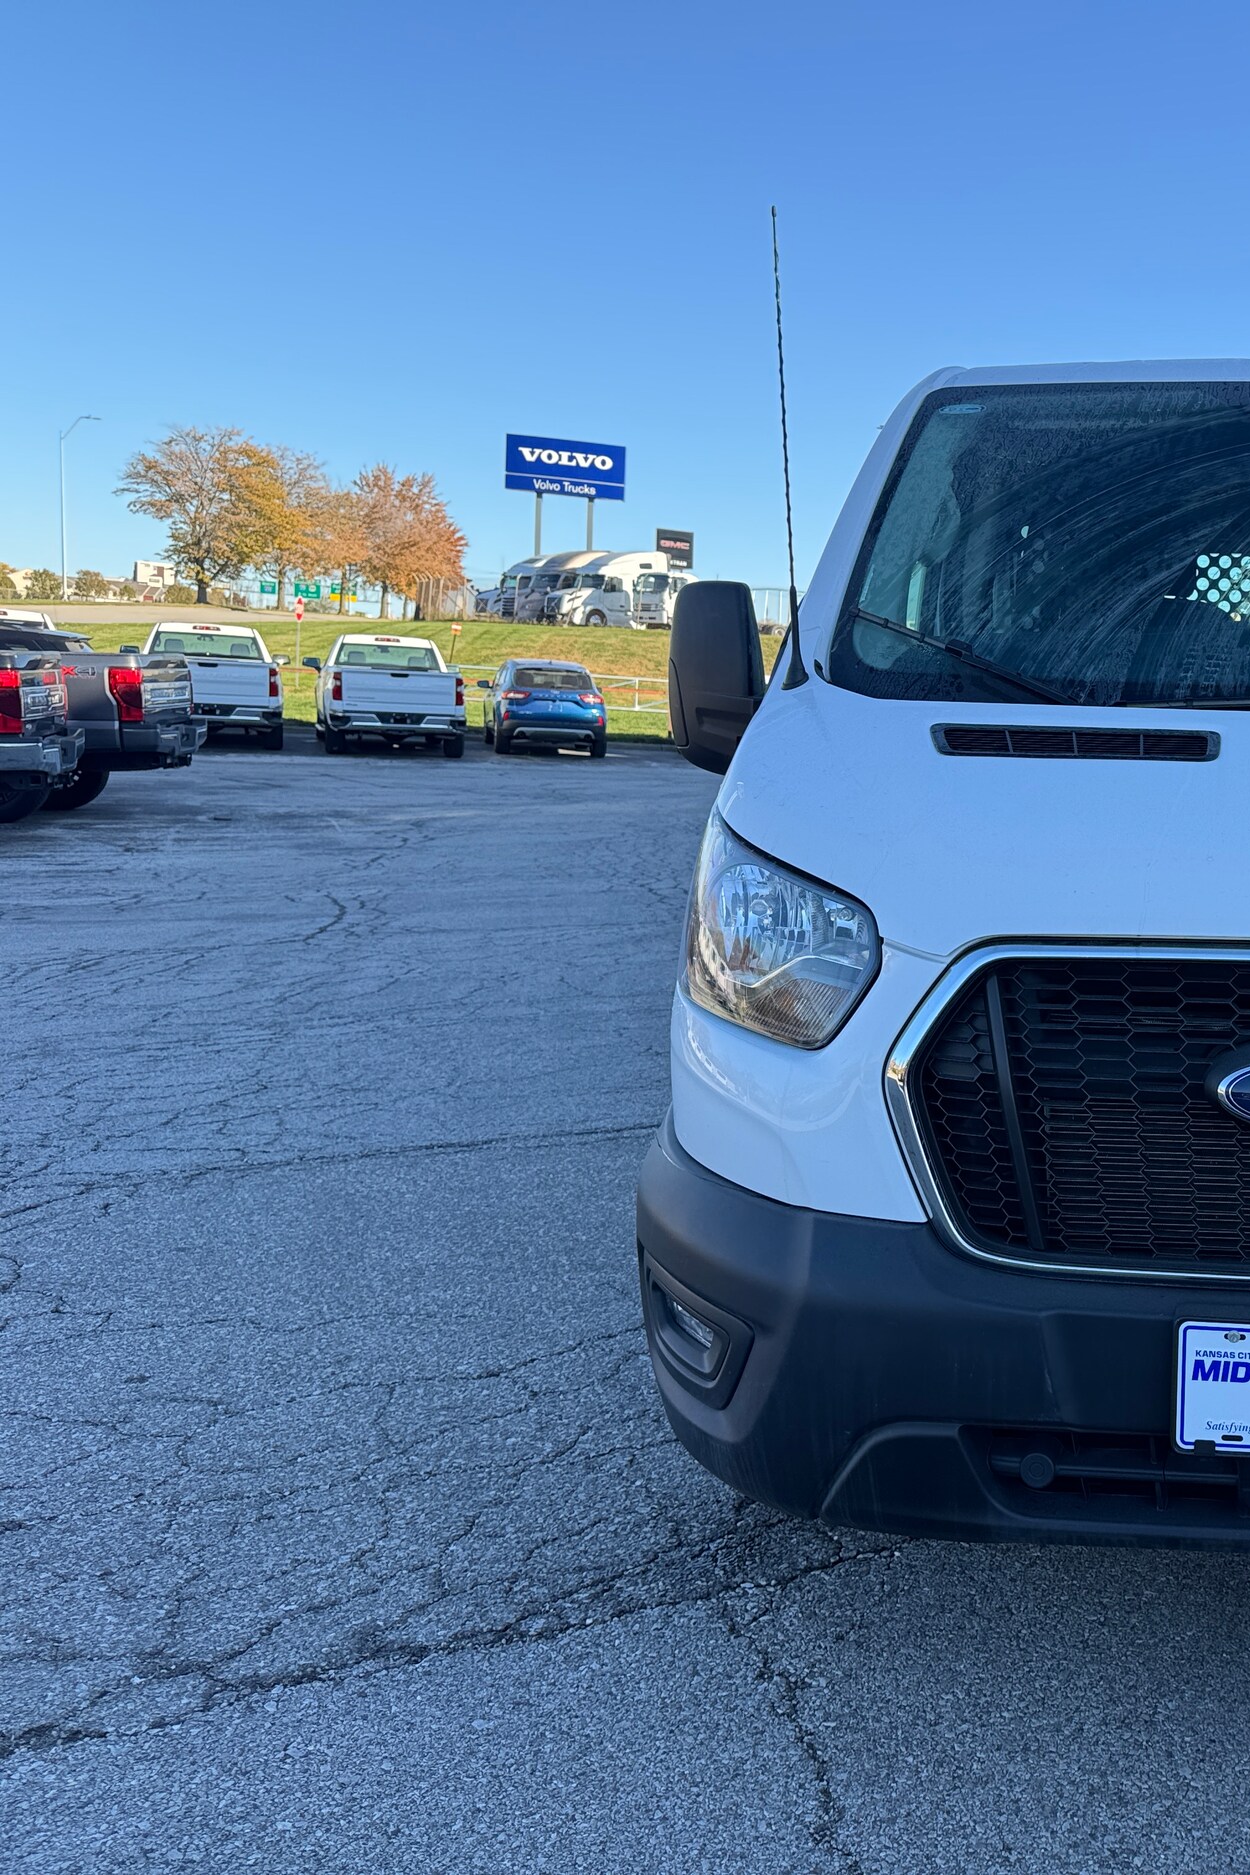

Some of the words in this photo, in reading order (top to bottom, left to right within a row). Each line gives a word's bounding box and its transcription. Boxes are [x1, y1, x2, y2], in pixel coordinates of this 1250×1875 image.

[518, 446, 613, 471] VOLVO
[533, 478, 560, 491] Volvo
[563, 481, 596, 495] Trucks
[660, 539, 690, 550] GMC
[1195, 1350, 1235, 1359] KANSAS
